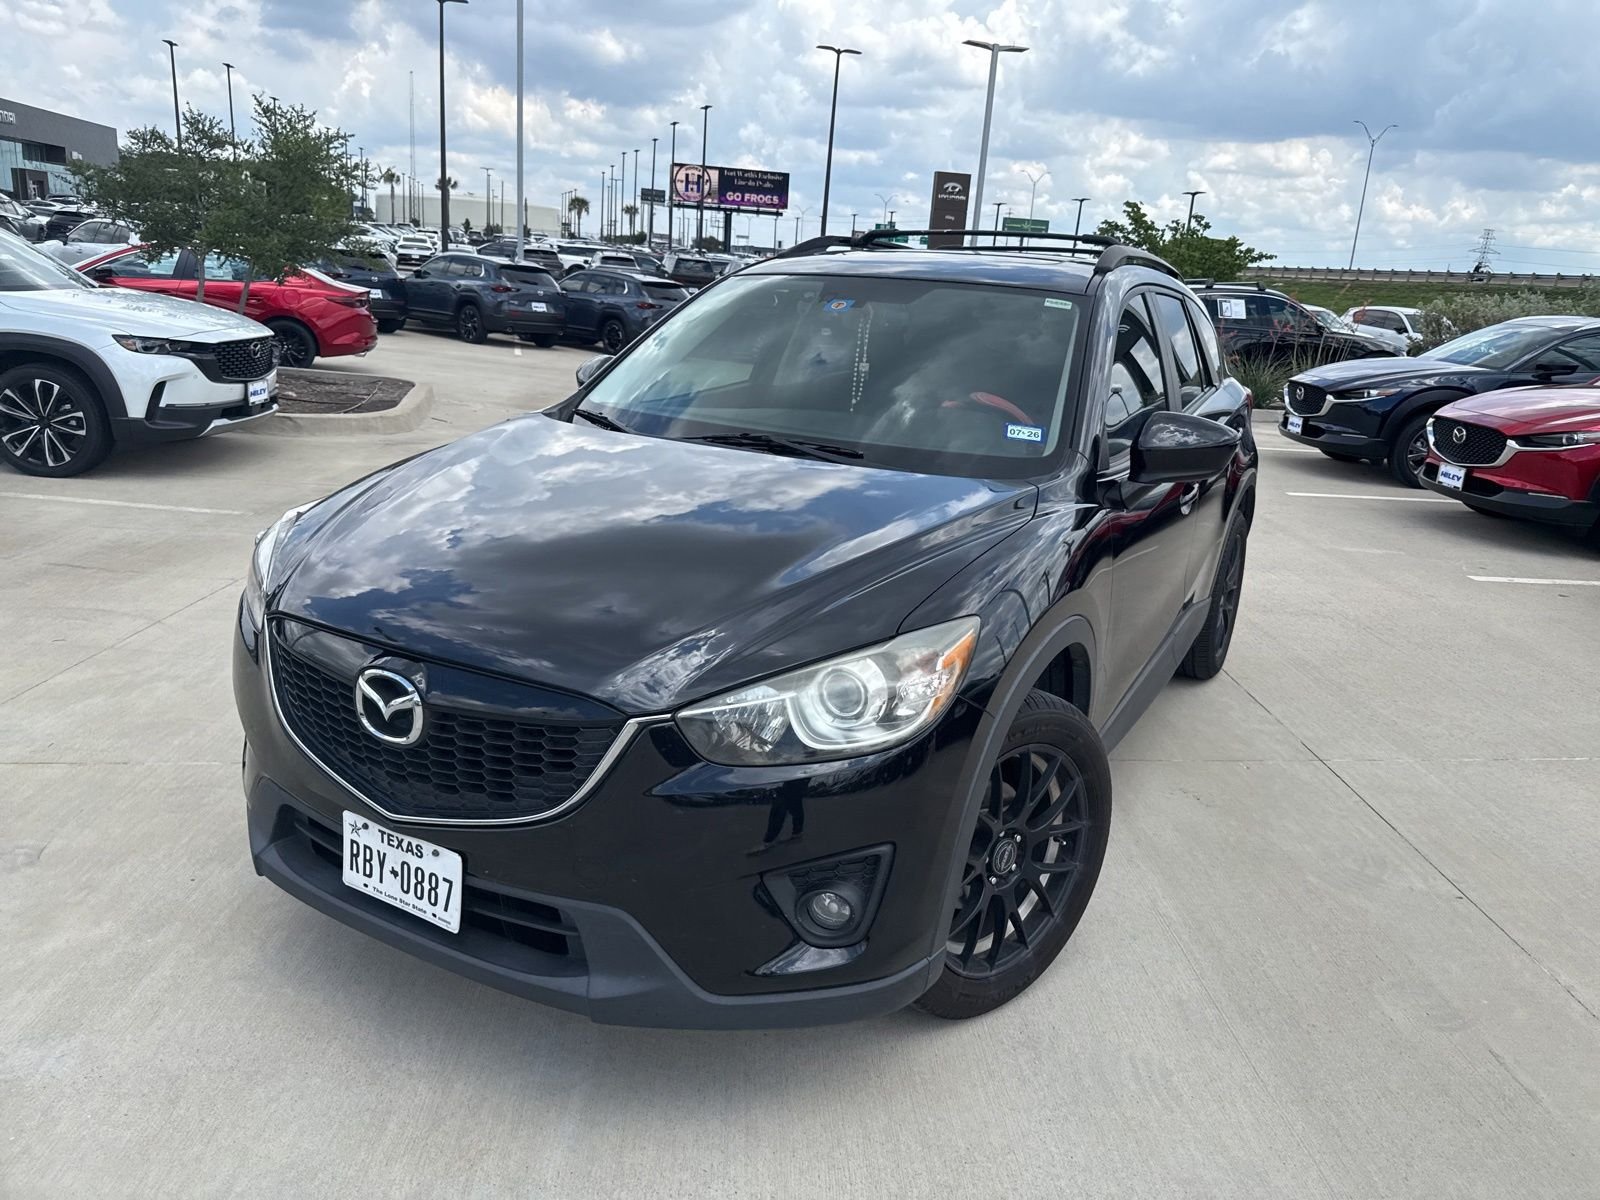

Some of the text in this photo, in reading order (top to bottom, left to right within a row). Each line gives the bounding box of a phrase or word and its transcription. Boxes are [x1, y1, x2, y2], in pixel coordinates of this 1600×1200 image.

[726, 191, 779, 205] GO FROGS
[1009, 428, 1040, 438] 07 26
[1440, 470, 1462, 481] HILEY
[378, 829, 424, 859] TEXAS
[350, 838, 453, 913] RBY 0887
[372, 886, 427, 914] The Lone Star State
